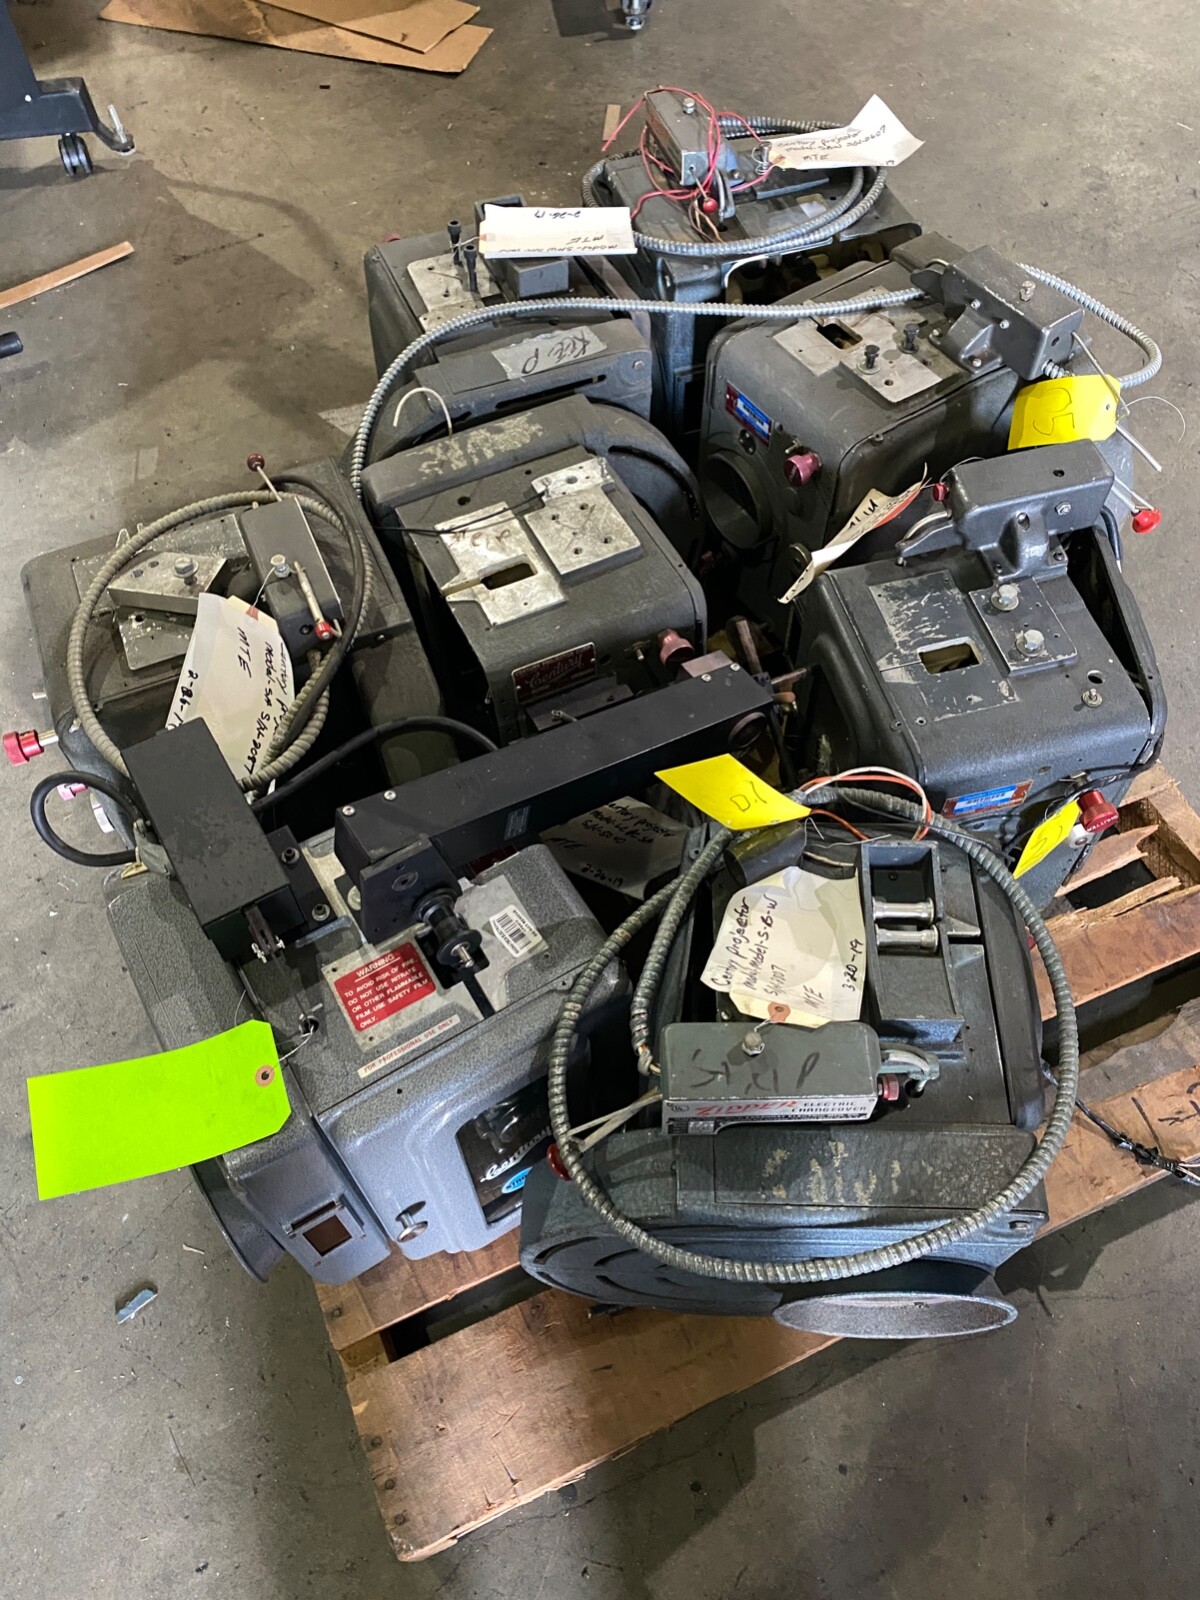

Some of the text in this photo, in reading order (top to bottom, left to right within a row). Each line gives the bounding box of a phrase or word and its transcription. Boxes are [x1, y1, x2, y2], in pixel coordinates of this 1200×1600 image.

[803, 153, 831, 161] MTE
[565, 234, 604, 246] MTE
[236, 626, 252, 679] MTE
[344, 990, 354, 998] TO
[356, 979, 375, 994] AVOID
[375, 971, 391, 983] RISK
[390, 965, 400, 974] OF
[356, 953, 396, 978] WARNING
[347, 966, 417, 1007] DO NOT USE NITRATE
[351, 971, 424, 1014] OR OTHER FLAMMABLE
[372, 1000, 387, 1012] USE
[387, 987, 412, 1004] SAFETY
[413, 978, 429, 990] FILM
[363, 1019, 454, 1074] FOR PROFESSIONAL USE ONLY
[695, 1100, 799, 1117] ZIPPER
